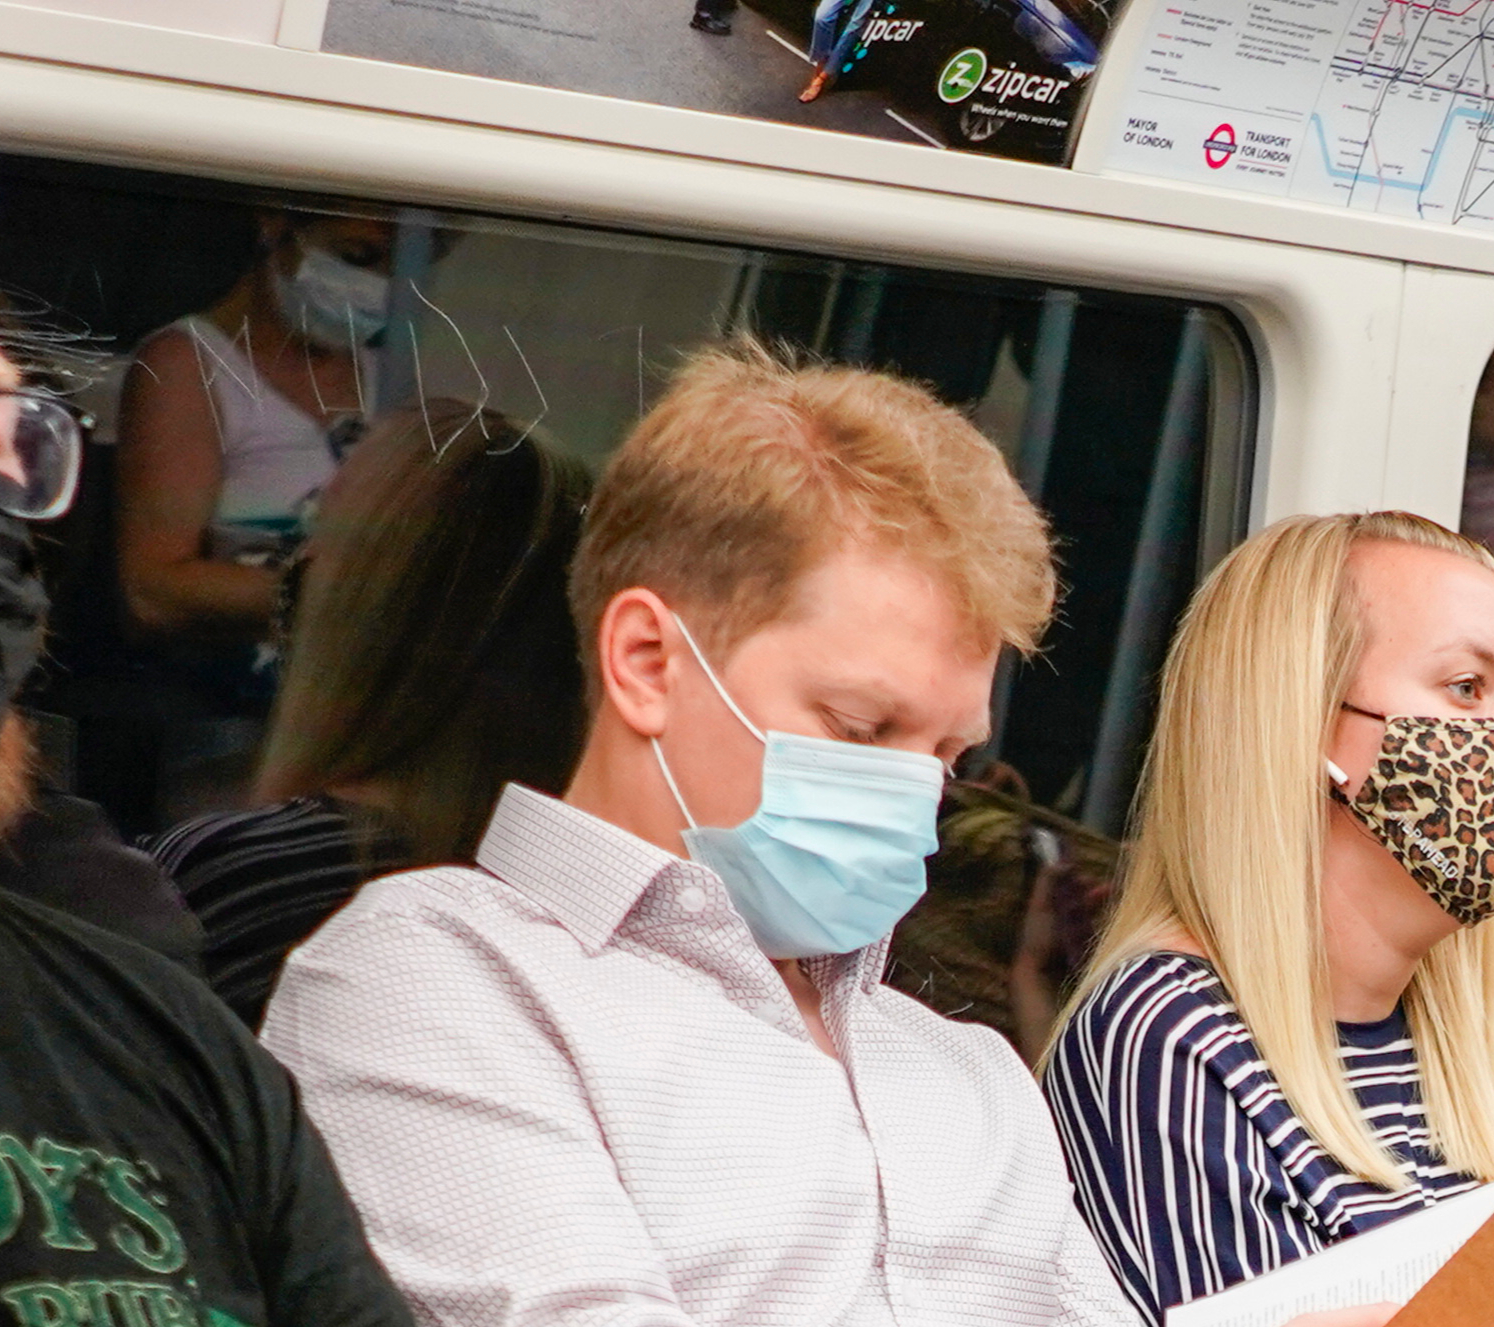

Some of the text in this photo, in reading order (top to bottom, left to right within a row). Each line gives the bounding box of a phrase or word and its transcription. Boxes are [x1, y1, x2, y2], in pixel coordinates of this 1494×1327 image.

[862, 12, 924, 47] ipcar
[981, 62, 1069, 104] zipcar
[1127, 117, 1158, 132] MAYOR
[1123, 131, 1173, 150] OF LONDON
[1246, 130, 1291, 149] TRANSPORT
[1240, 145, 1291, 163] FOR LONDON
